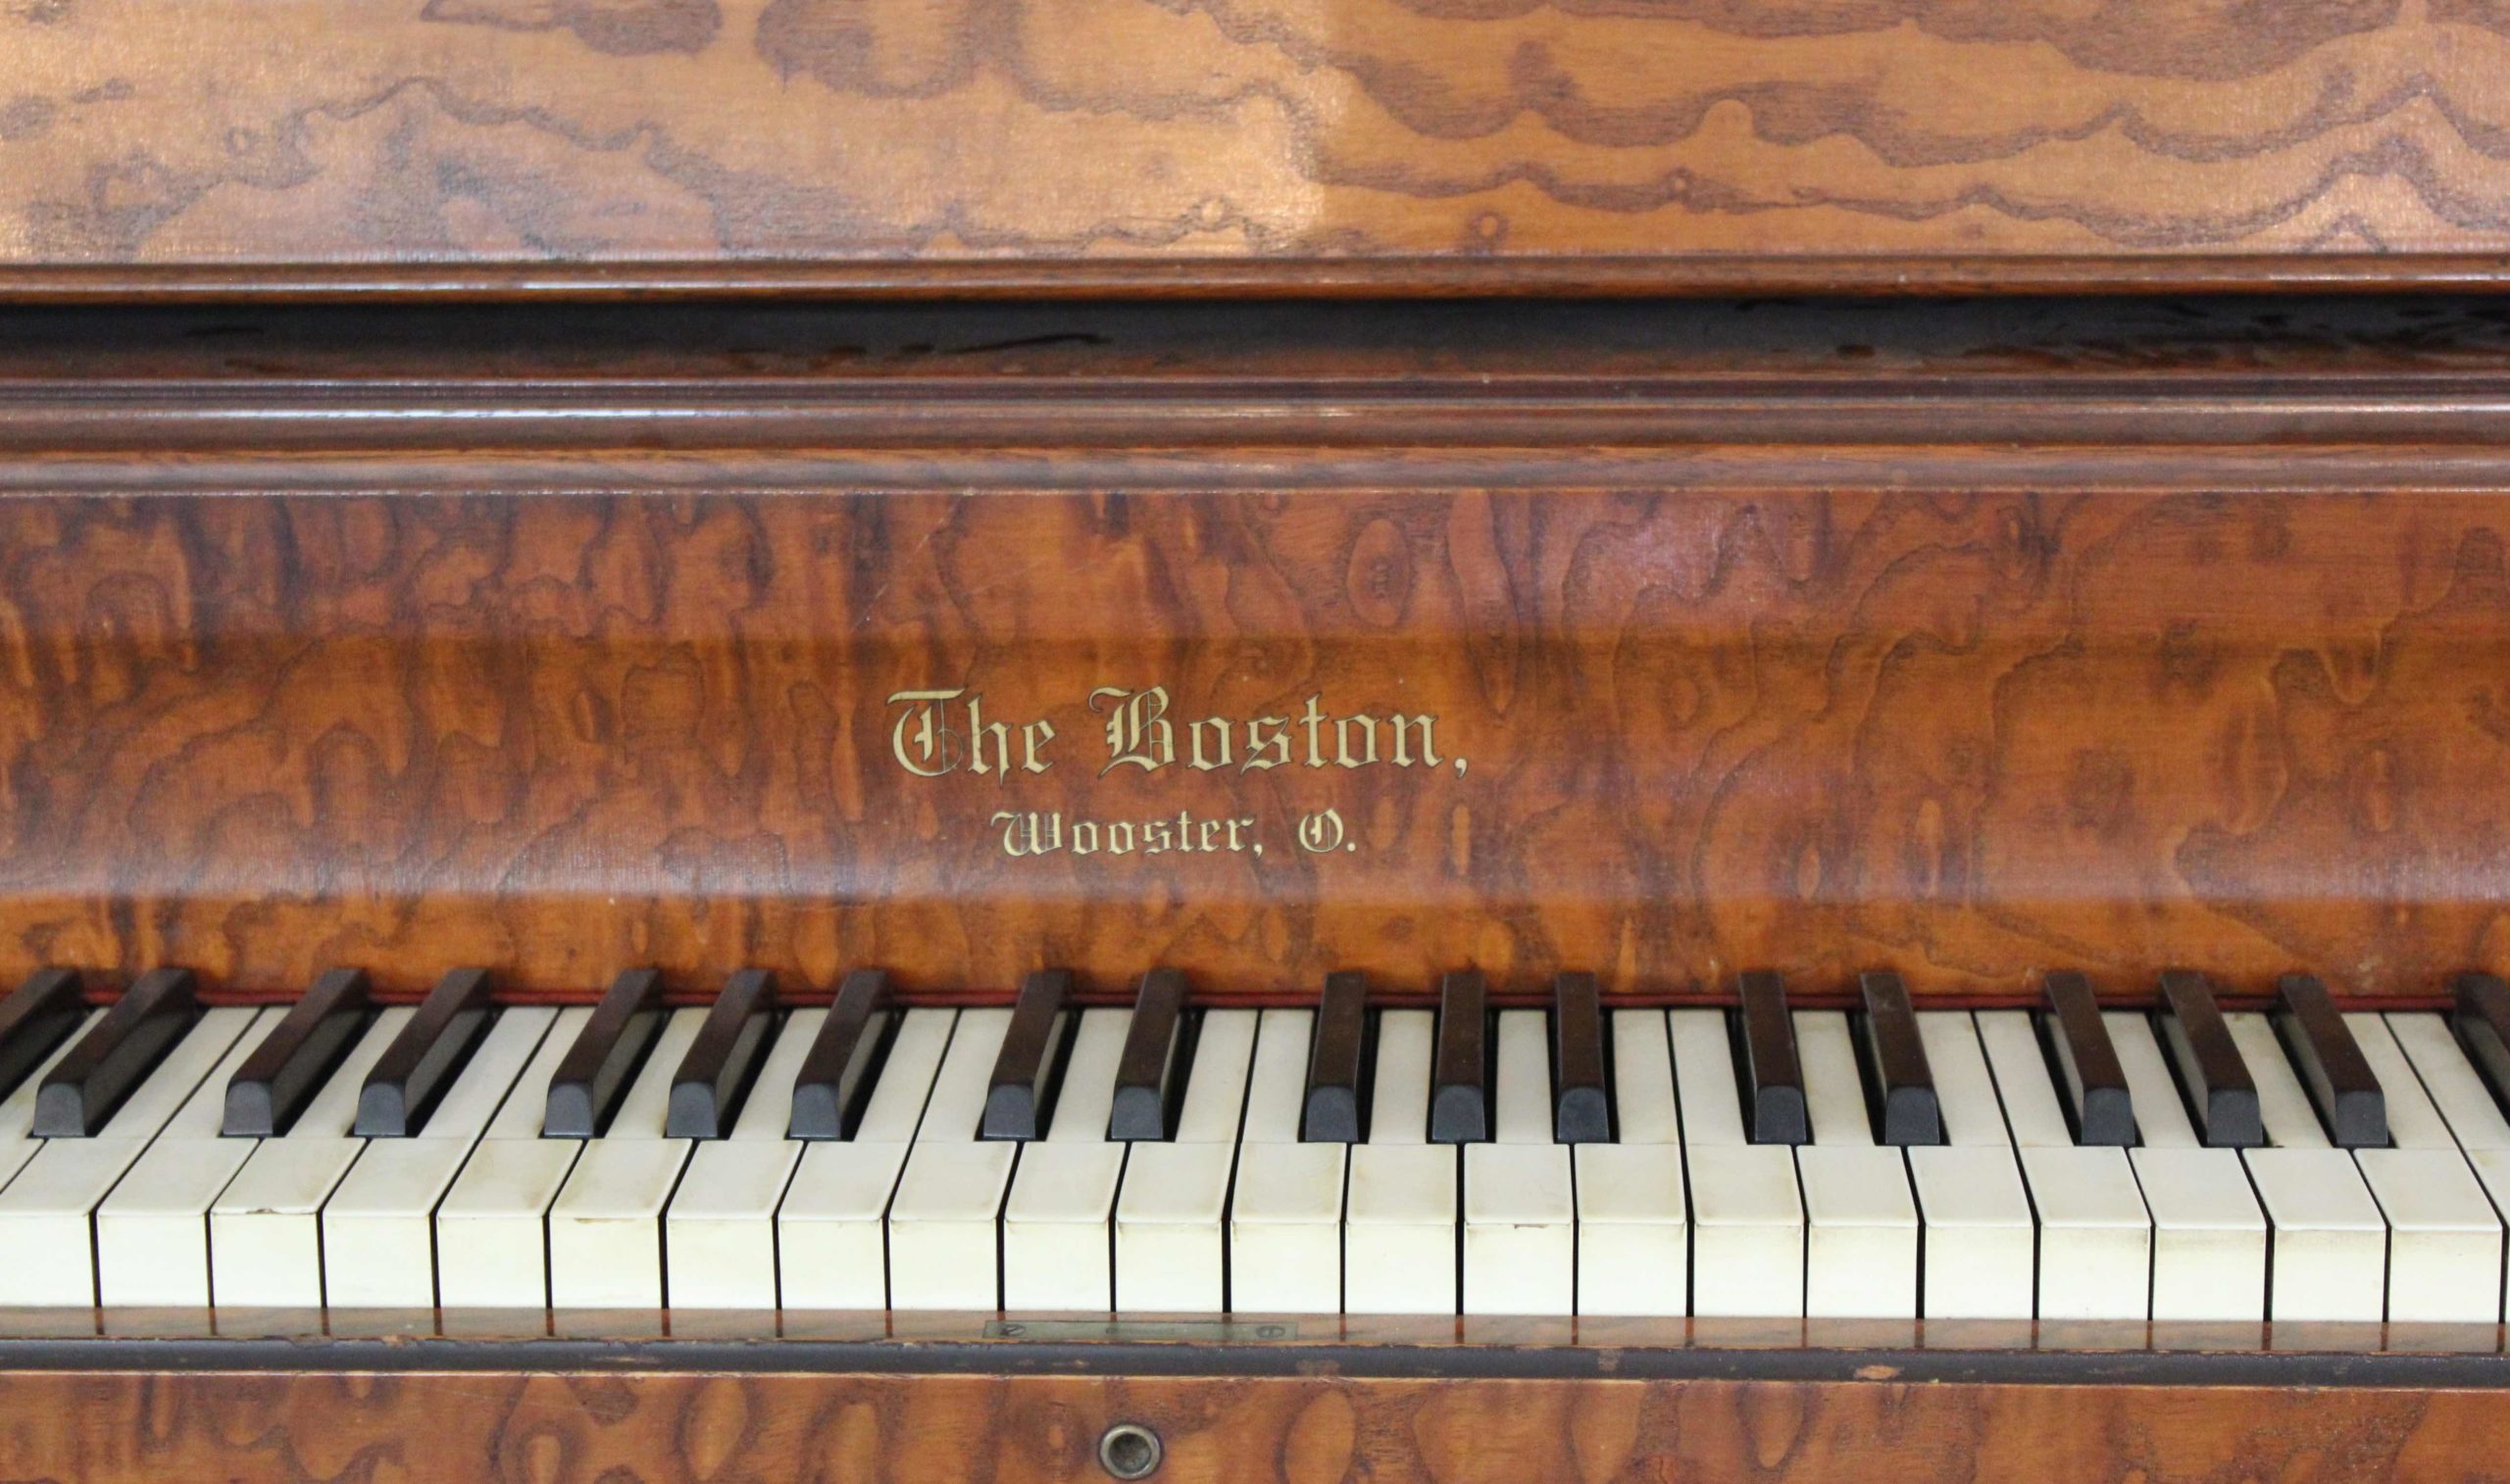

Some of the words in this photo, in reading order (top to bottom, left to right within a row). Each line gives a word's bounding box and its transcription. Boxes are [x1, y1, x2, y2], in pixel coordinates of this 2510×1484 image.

[886, 688, 1056, 784] The
[1089, 686, 1469, 778] Boston,
[990, 810, 1263, 858] Wooster,
[1298, 809, 1357, 854] O.
